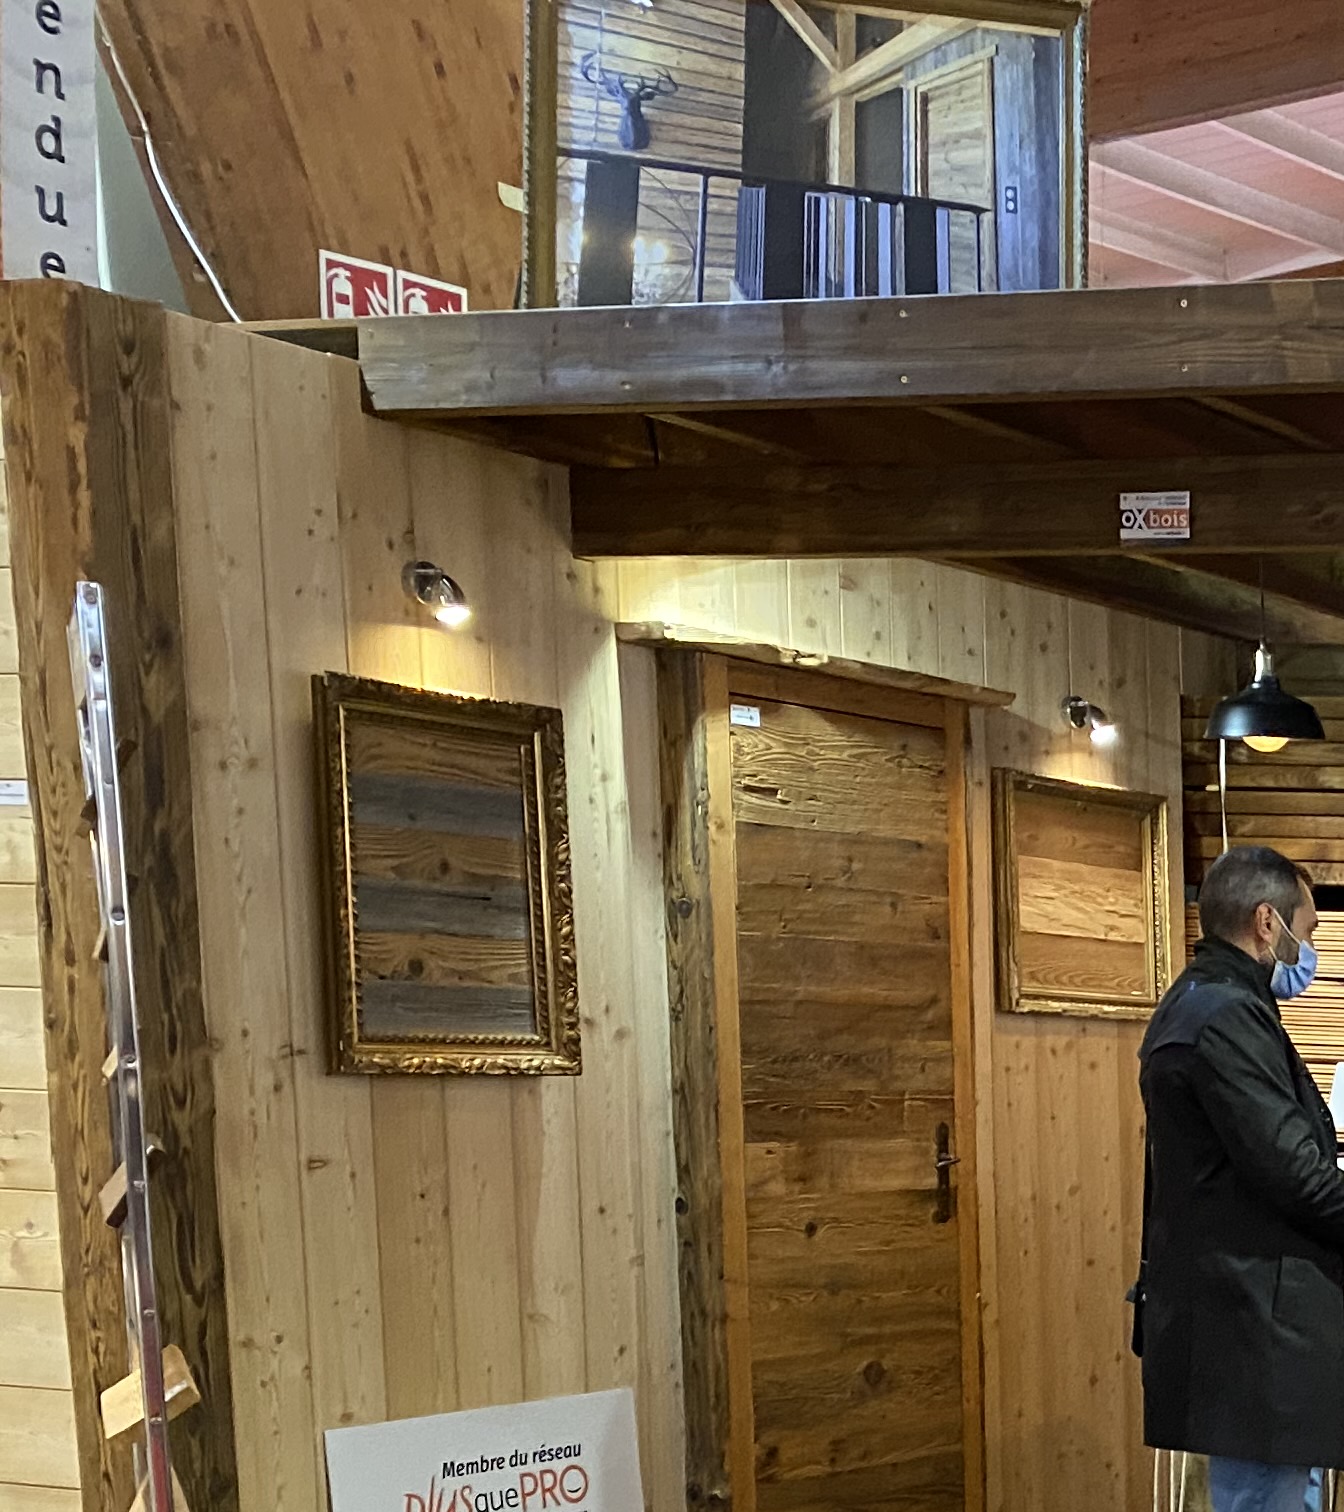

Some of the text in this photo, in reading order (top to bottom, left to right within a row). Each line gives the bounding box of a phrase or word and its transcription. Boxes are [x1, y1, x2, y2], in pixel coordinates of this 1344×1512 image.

[442, 1443, 582, 1480] Membre du réseau
